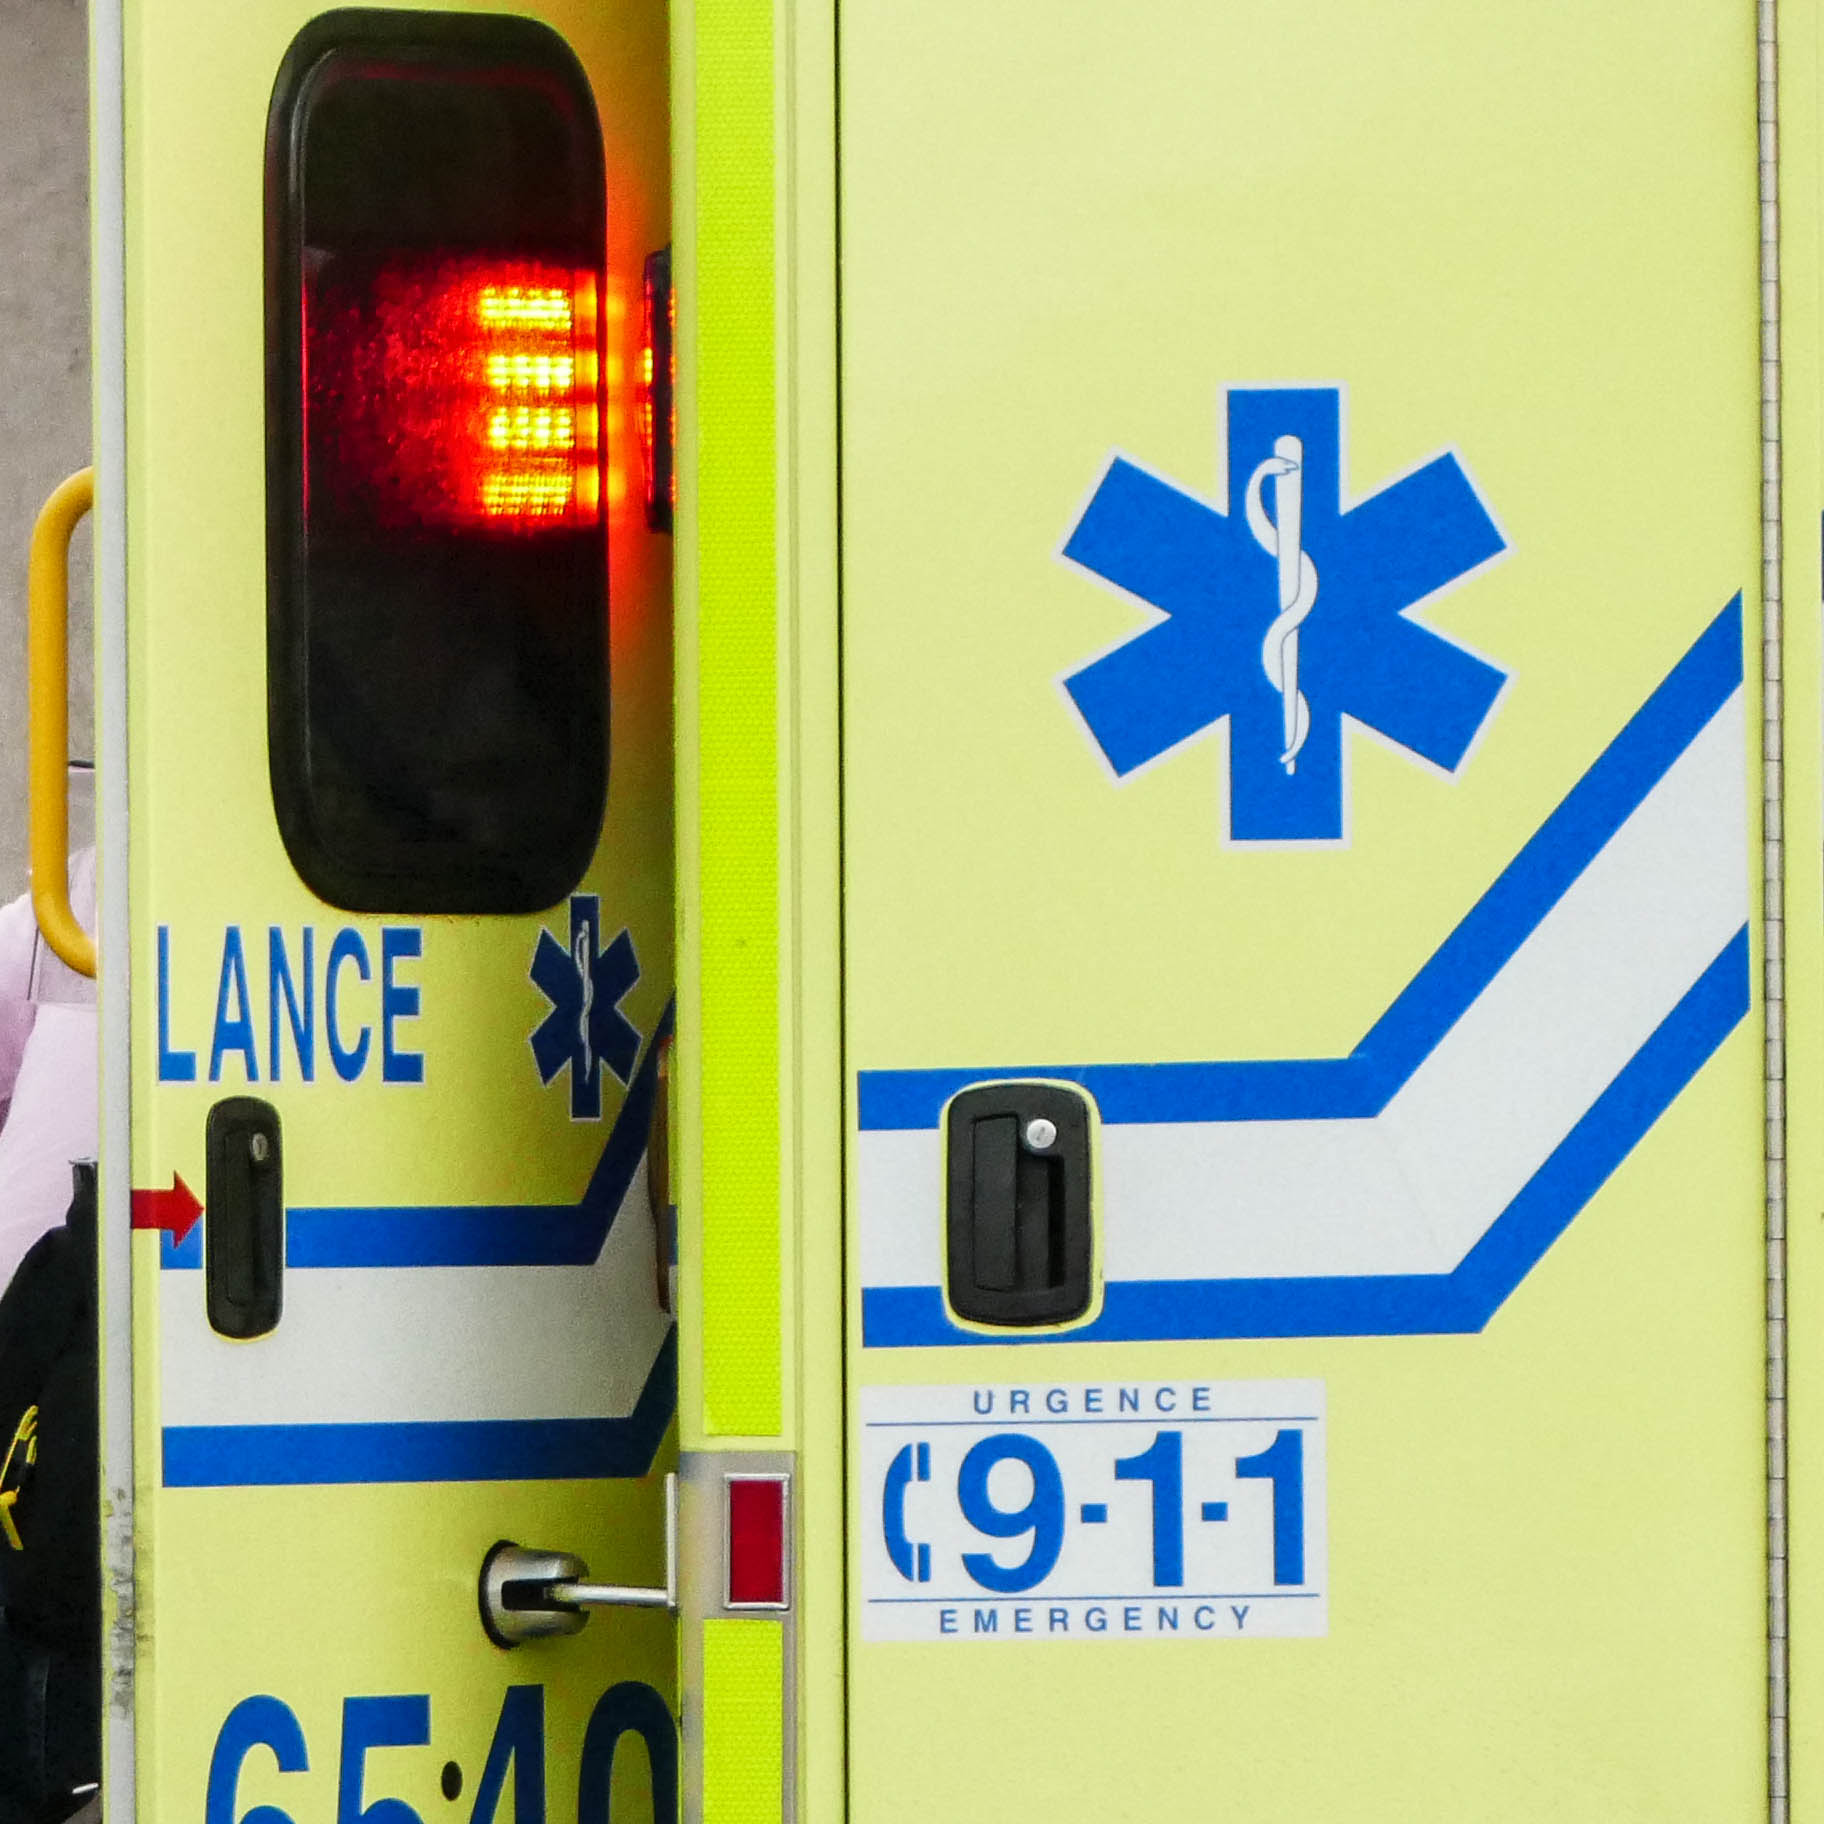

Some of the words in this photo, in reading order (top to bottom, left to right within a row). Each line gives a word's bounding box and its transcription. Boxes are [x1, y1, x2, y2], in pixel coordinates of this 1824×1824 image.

[156, 925, 425, 1085] LANCE
[973, 1386, 1214, 1416] URGENCE
[957, 1429, 1305, 1594] 9-1-1
[939, 1605, 1251, 1634] EMERGENCY
